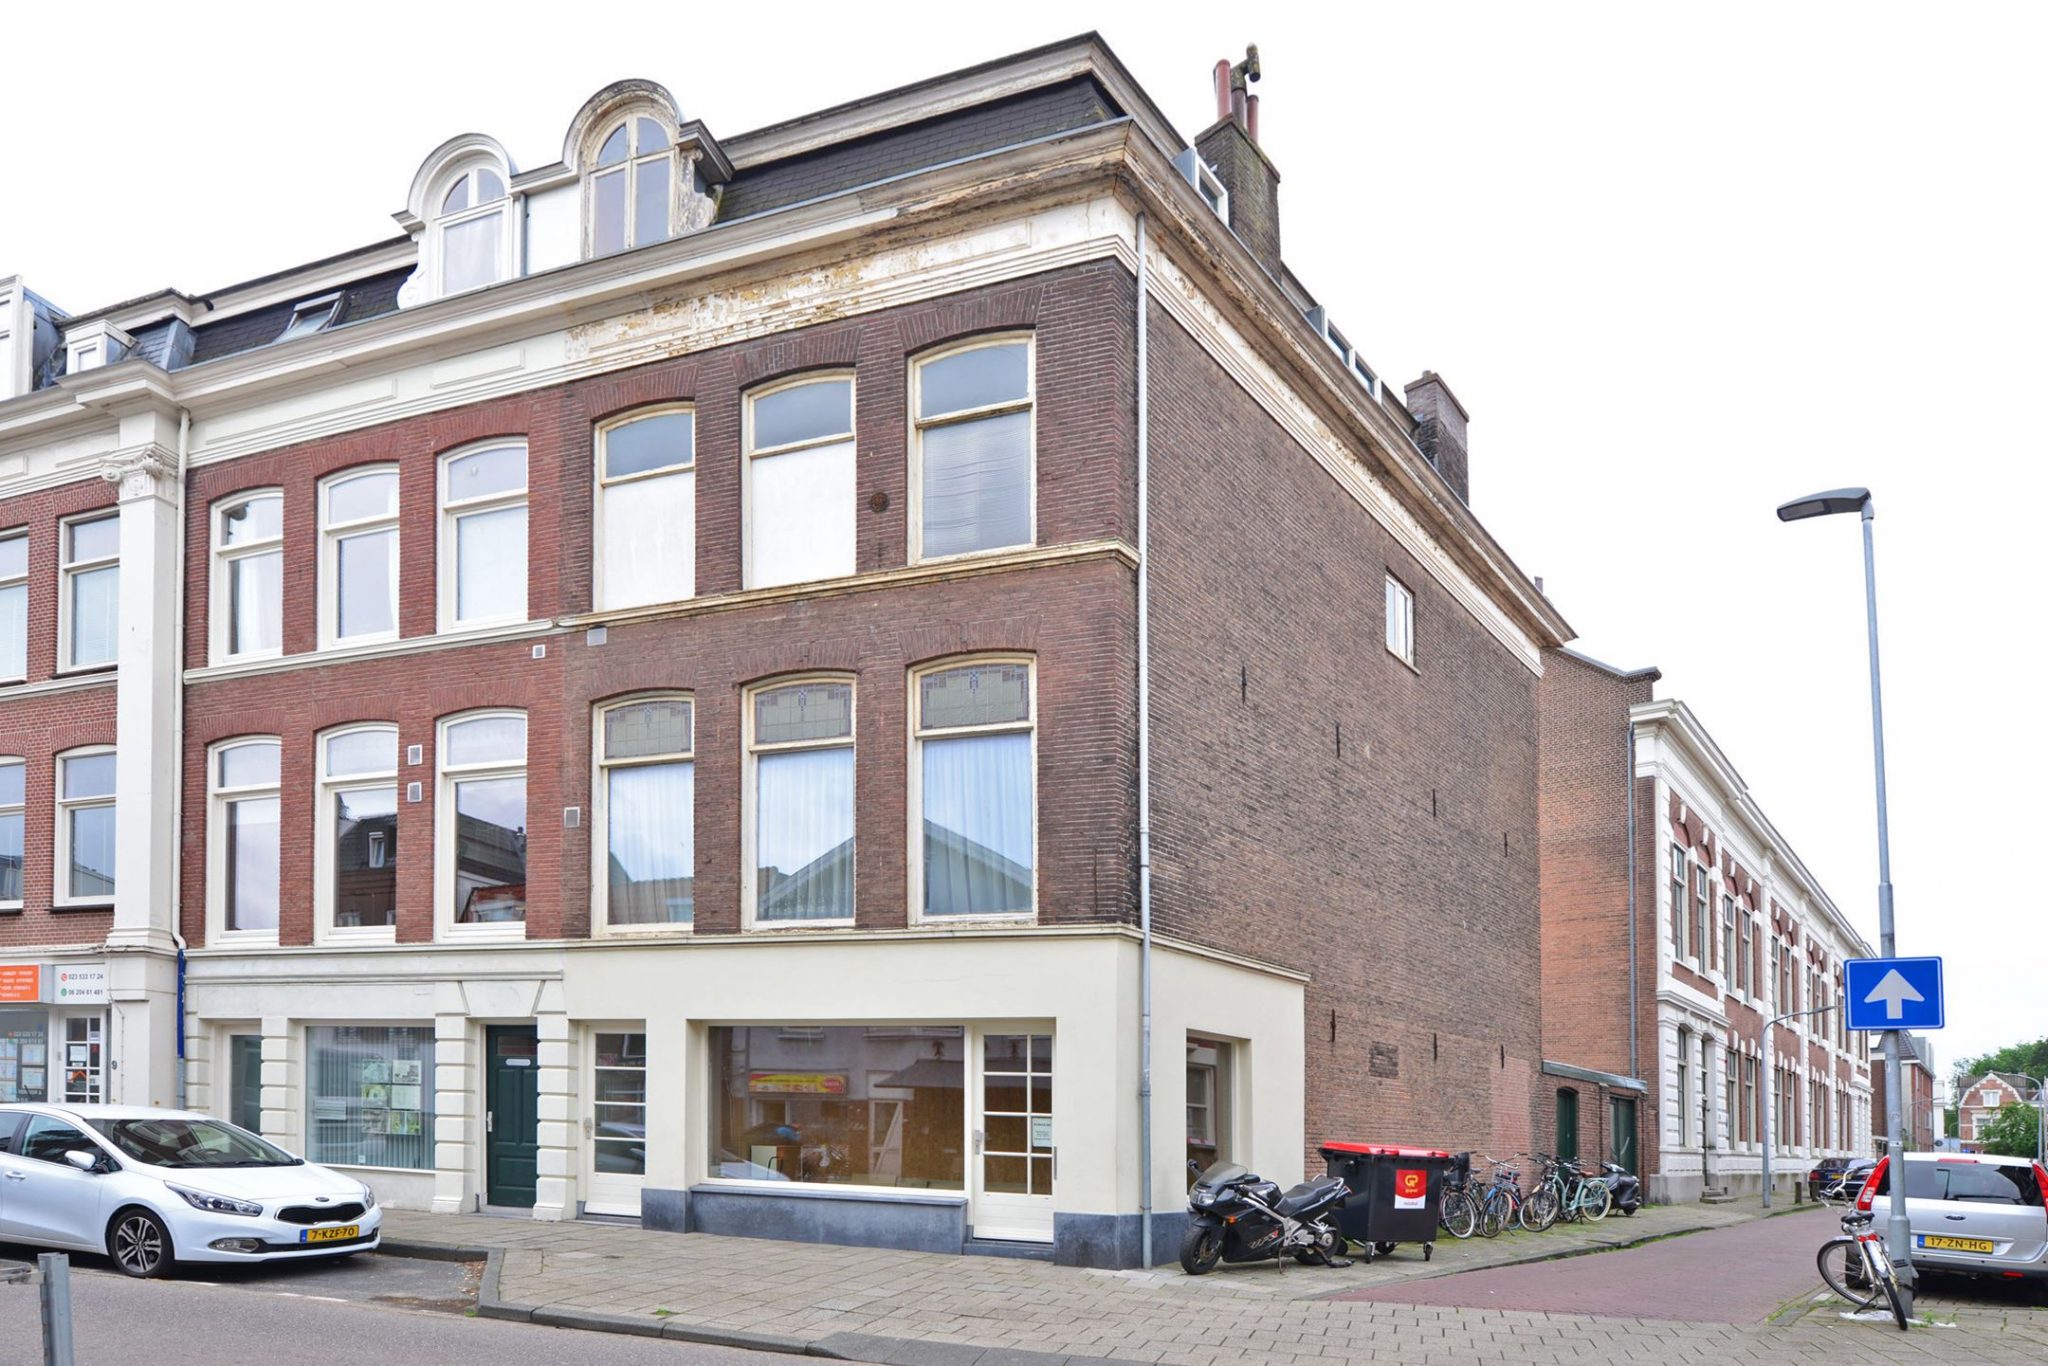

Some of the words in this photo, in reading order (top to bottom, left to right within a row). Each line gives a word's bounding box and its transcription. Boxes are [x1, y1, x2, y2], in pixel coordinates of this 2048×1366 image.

[111, 1060, 118, 1070] 9
[311, 1227, 355, 1241] 7-KZF-70
[1930, 1237, 1987, 1250] 17-ZN-HG
